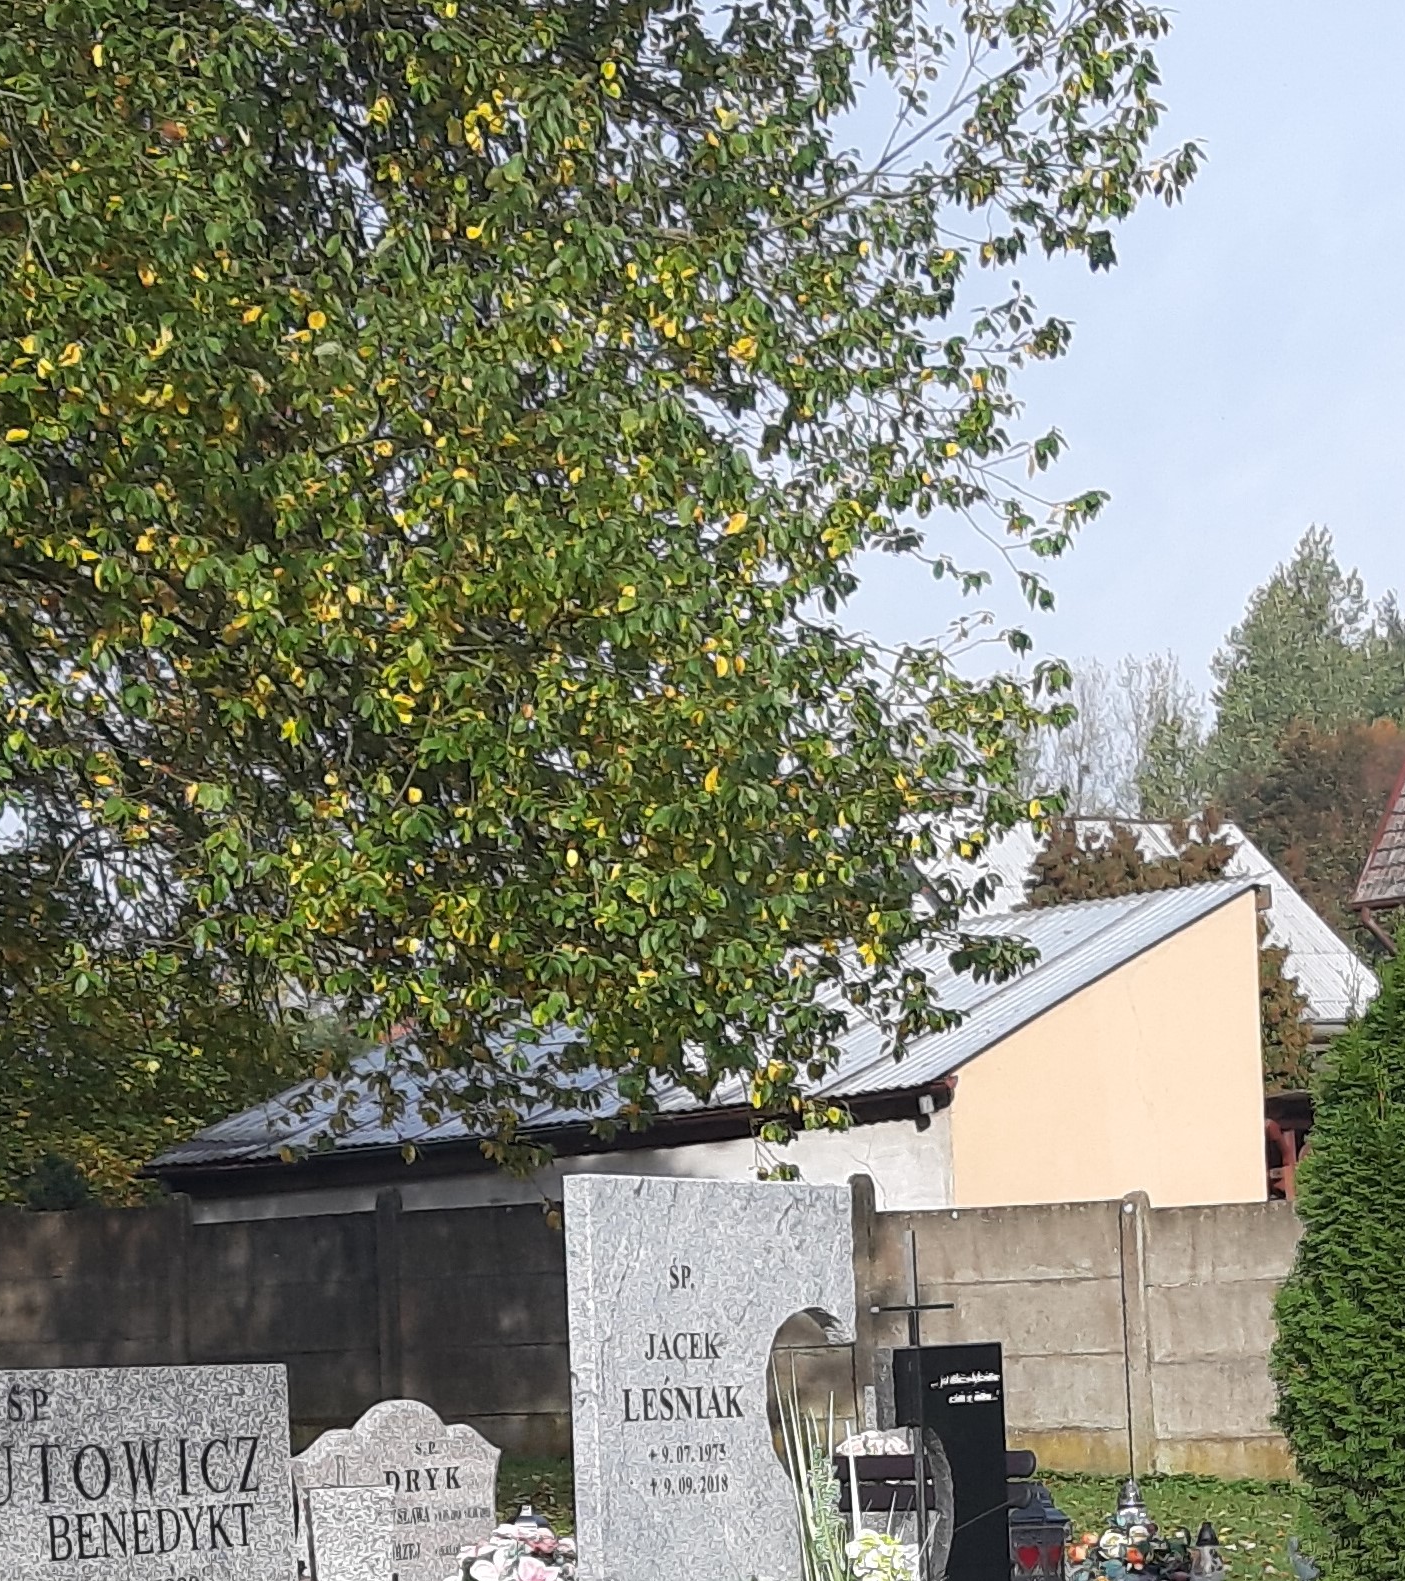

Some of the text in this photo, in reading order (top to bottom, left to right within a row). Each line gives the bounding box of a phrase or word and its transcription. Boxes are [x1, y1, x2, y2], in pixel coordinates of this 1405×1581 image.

[644, 1332, 721, 1361] JACEK
[622, 1376, 744, 1422] LEŚNIAK
[383, 1466, 462, 1493] DRYK
[48, 1503, 254, 1562] BENEDYKT
